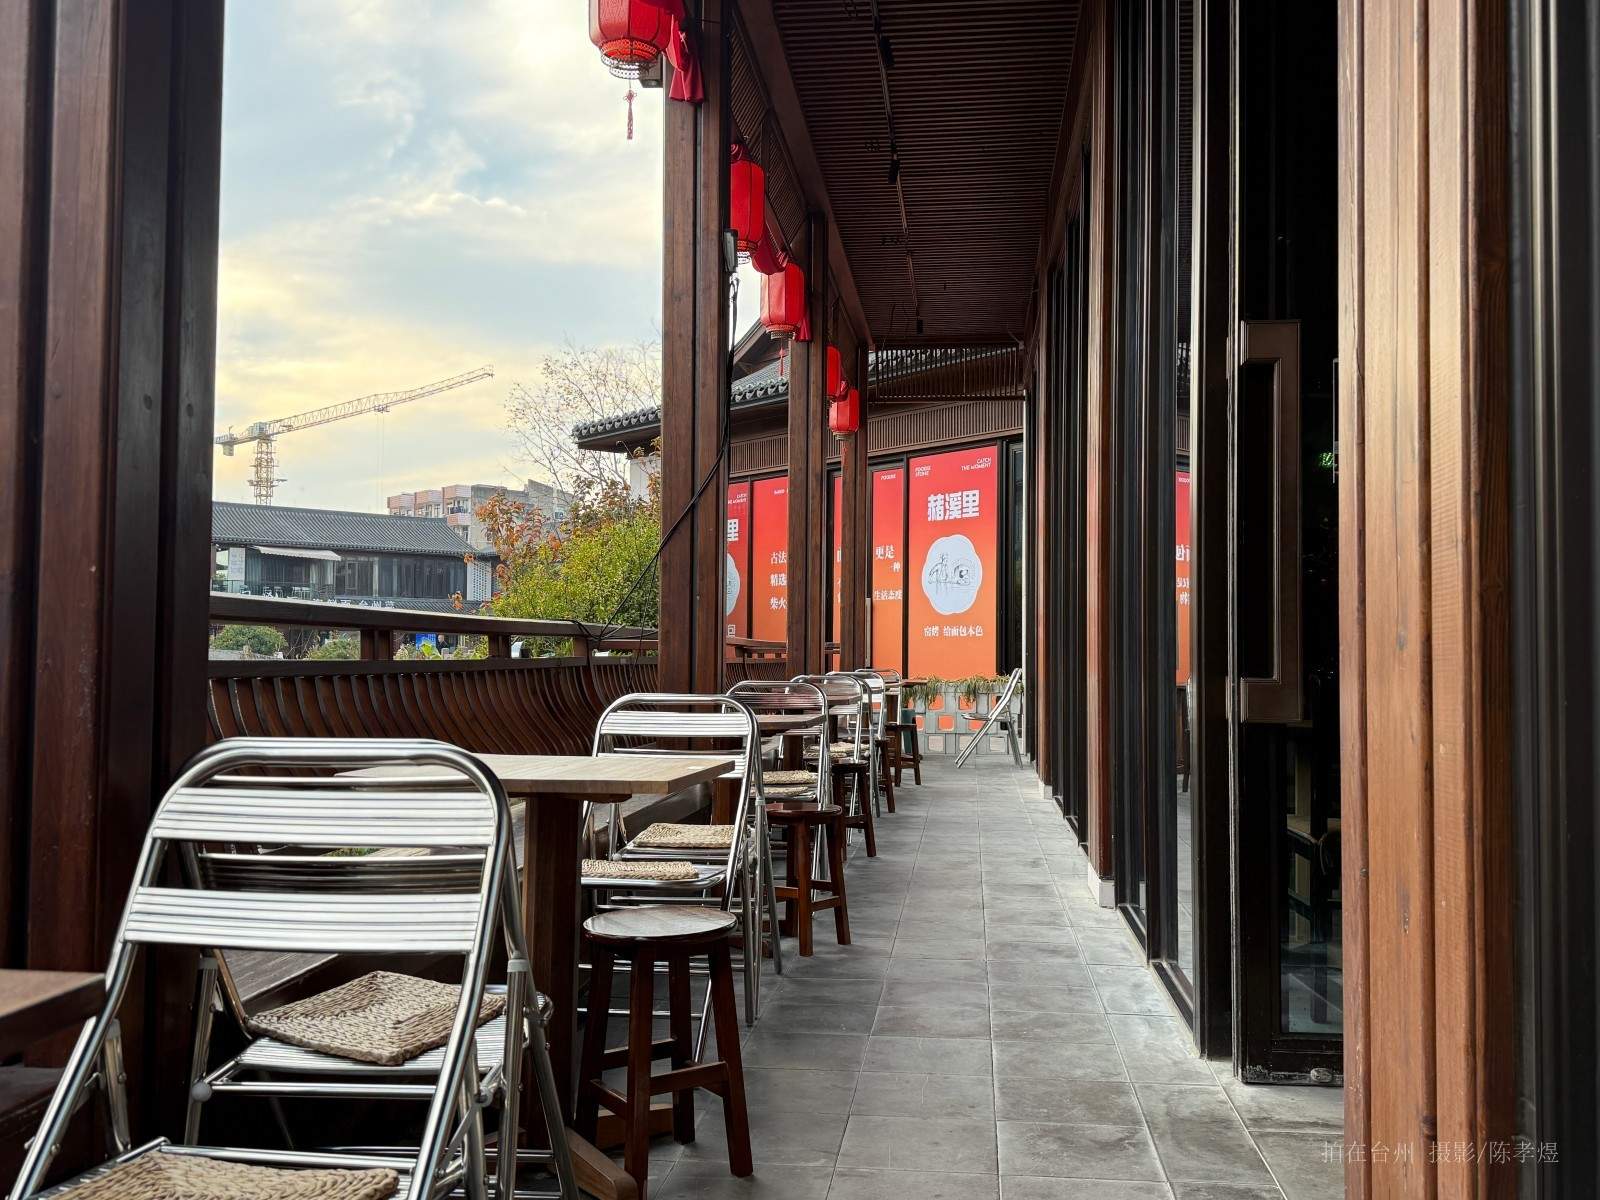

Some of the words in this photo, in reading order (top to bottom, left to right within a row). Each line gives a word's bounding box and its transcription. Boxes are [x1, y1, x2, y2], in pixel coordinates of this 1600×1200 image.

[875, 545, 895, 560] 更是
[770, 596, 787, 610] 柴火
[943, 625, 984, 637] 给面包本色
